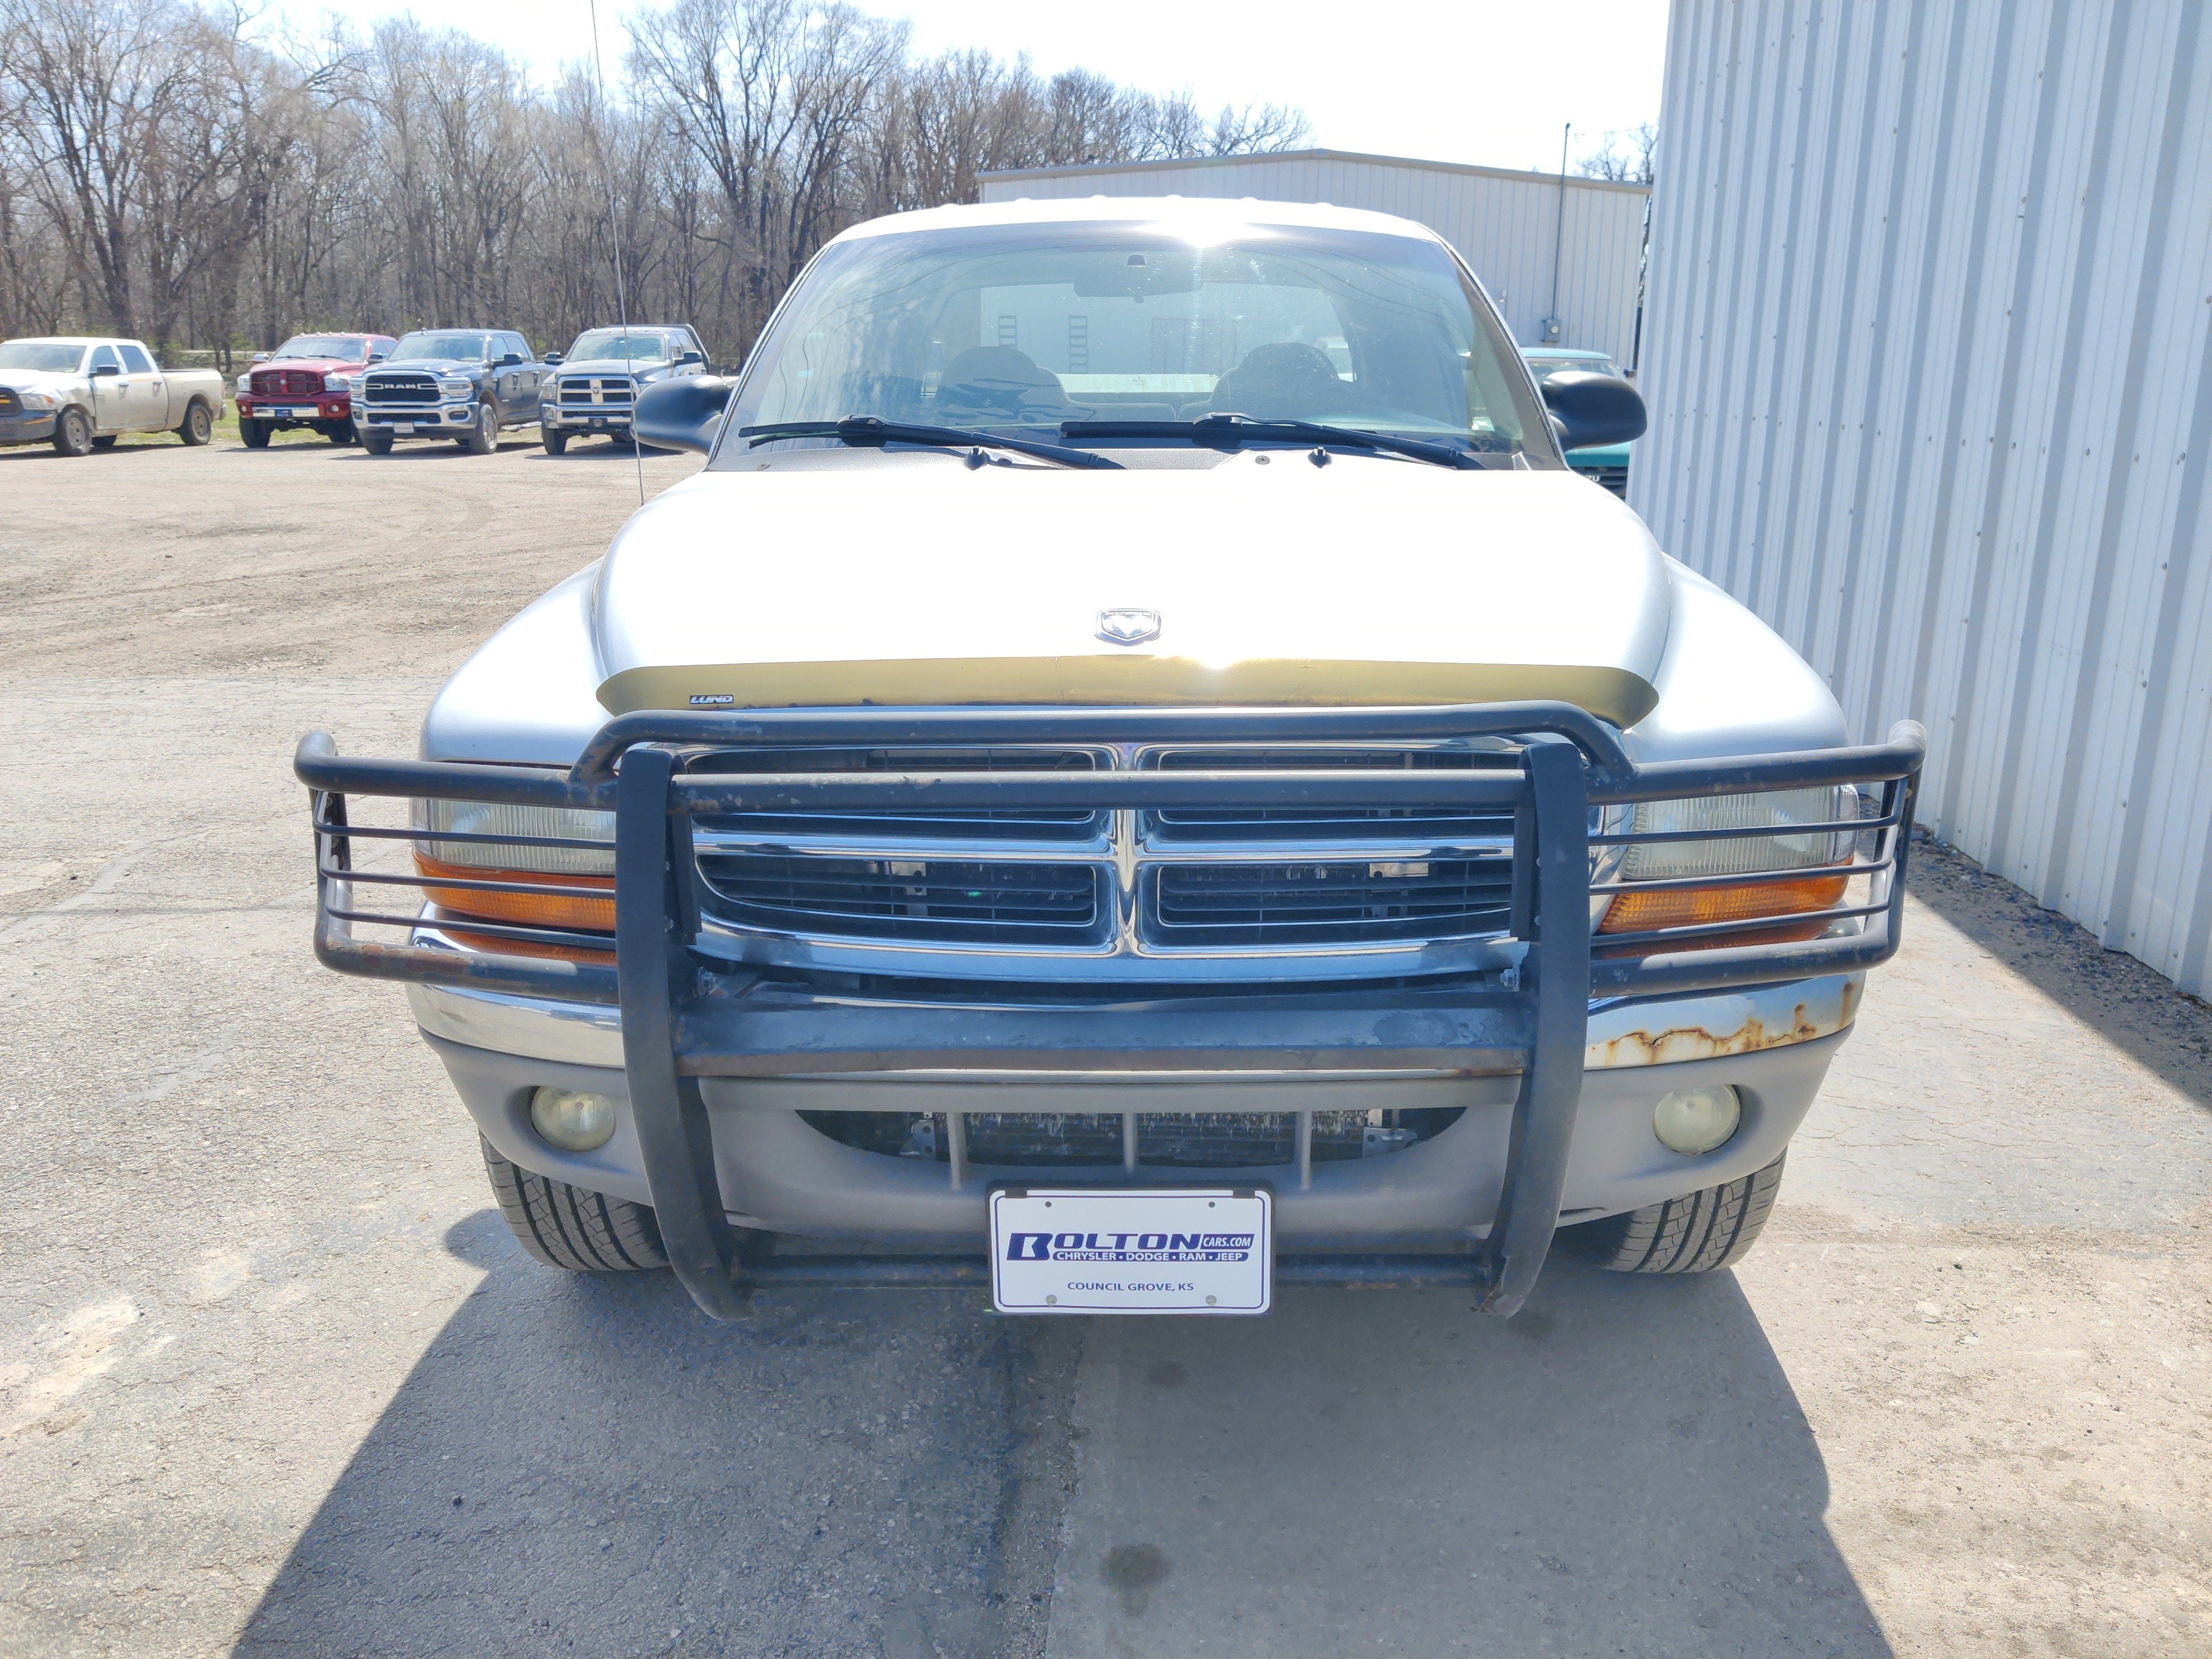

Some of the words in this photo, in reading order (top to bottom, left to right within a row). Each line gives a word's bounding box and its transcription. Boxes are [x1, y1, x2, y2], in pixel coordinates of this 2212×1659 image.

[690, 695, 733, 703] LUND
[1056, 1252, 1117, 1260] CHRYSLER
[1126, 1253, 1170, 1261] DODGE
[1179, 1253, 1206, 1261] RAM
[1215, 1253, 1243, 1261] JEEP
[1067, 1282, 1124, 1291] COUNCIL
[1128, 1282, 1175, 1292] GROVE,
[1178, 1282, 1194, 1291] KS
